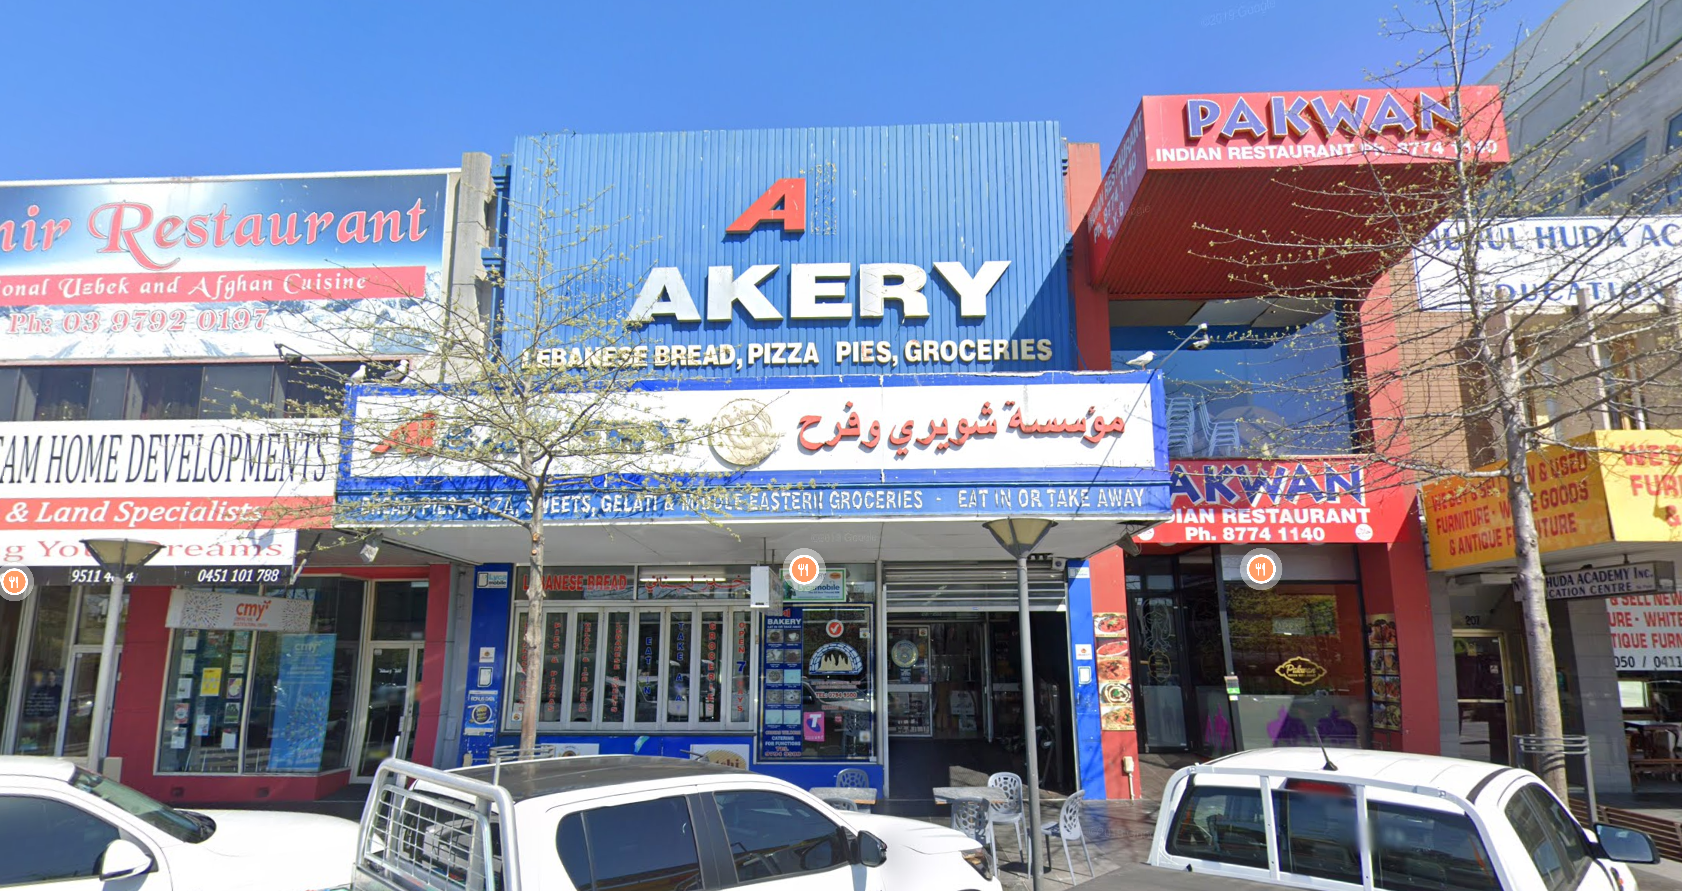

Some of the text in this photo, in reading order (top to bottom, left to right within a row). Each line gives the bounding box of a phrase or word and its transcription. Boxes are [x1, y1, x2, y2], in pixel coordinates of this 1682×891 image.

[1185, 91, 1461, 143] PAKWAN
[1155, 147, 1223, 162] INDIAN
[1227, 143, 1356, 160] RESTAURANT
[1396, 140, 1444, 156] 8774
[726, 178, 806, 235] A
[87, 197, 428, 271] Restaurant
[1535, 225, 1627, 250] HUDA
[2, 273, 368, 301] onal Uzbek and Afghan Cuisine
[625, 260, 1012, 323] AKERY
[8, 308, 269, 334] Ph: 03 9792 0197
[521, 339, 1053, 370] LEBANESE BREAD, PIZZA PIES, GROCERIES
[798, 399, 1127, 460] مؤسسة شويري وفرح
[0, 432, 331, 484] AM HOME DEVELOPMENTS
[1538, 462, 1549, 482] &
[1549, 450, 1589, 478] USED
[601, 494, 657, 513] GELATI
[664, 495, 674, 511] &
[829, 489, 923, 509] GROCERIES
[958, 489, 989, 508] EAT
[994, 489, 1011, 508] IN
[1017, 488, 1043, 508] OR
[1046, 488, 1091, 508] TAKE
[1097, 487, 1144, 507] AWAY
[1540, 480, 1589, 510] GOODS
[5, 501, 264, 527] & Land Specialists
[1222, 508, 1370, 523] RESTAURANT
[1436, 505, 1490, 535] FURNITURE
[1185, 526, 1325, 540] Ph. 8774 1140
[1458, 527, 1503, 555] ANTIQUE
[1506, 512, 1577, 546] FITURE
[148, 540, 283, 558] reams
[71, 569, 100, 582] 9511
[197, 568, 279, 582] 0451 101 788
[523, 575, 627, 591] LANESE BREAD
[1546, 575, 1574, 588] HUDA
[1577, 567, 1630, 585] ACADEMY
[1589, 582, 1632, 594] CENTRE
[236, 600, 272, 621] cmy
[645, 637, 653, 665] EAT
[677, 622, 685, 661] TAKE
[738, 622, 746, 653] OPEN
[1611, 633, 1648, 648] TIQUE
[707, 622, 717, 712] GROCERIES
[736, 661, 746, 672] 7
